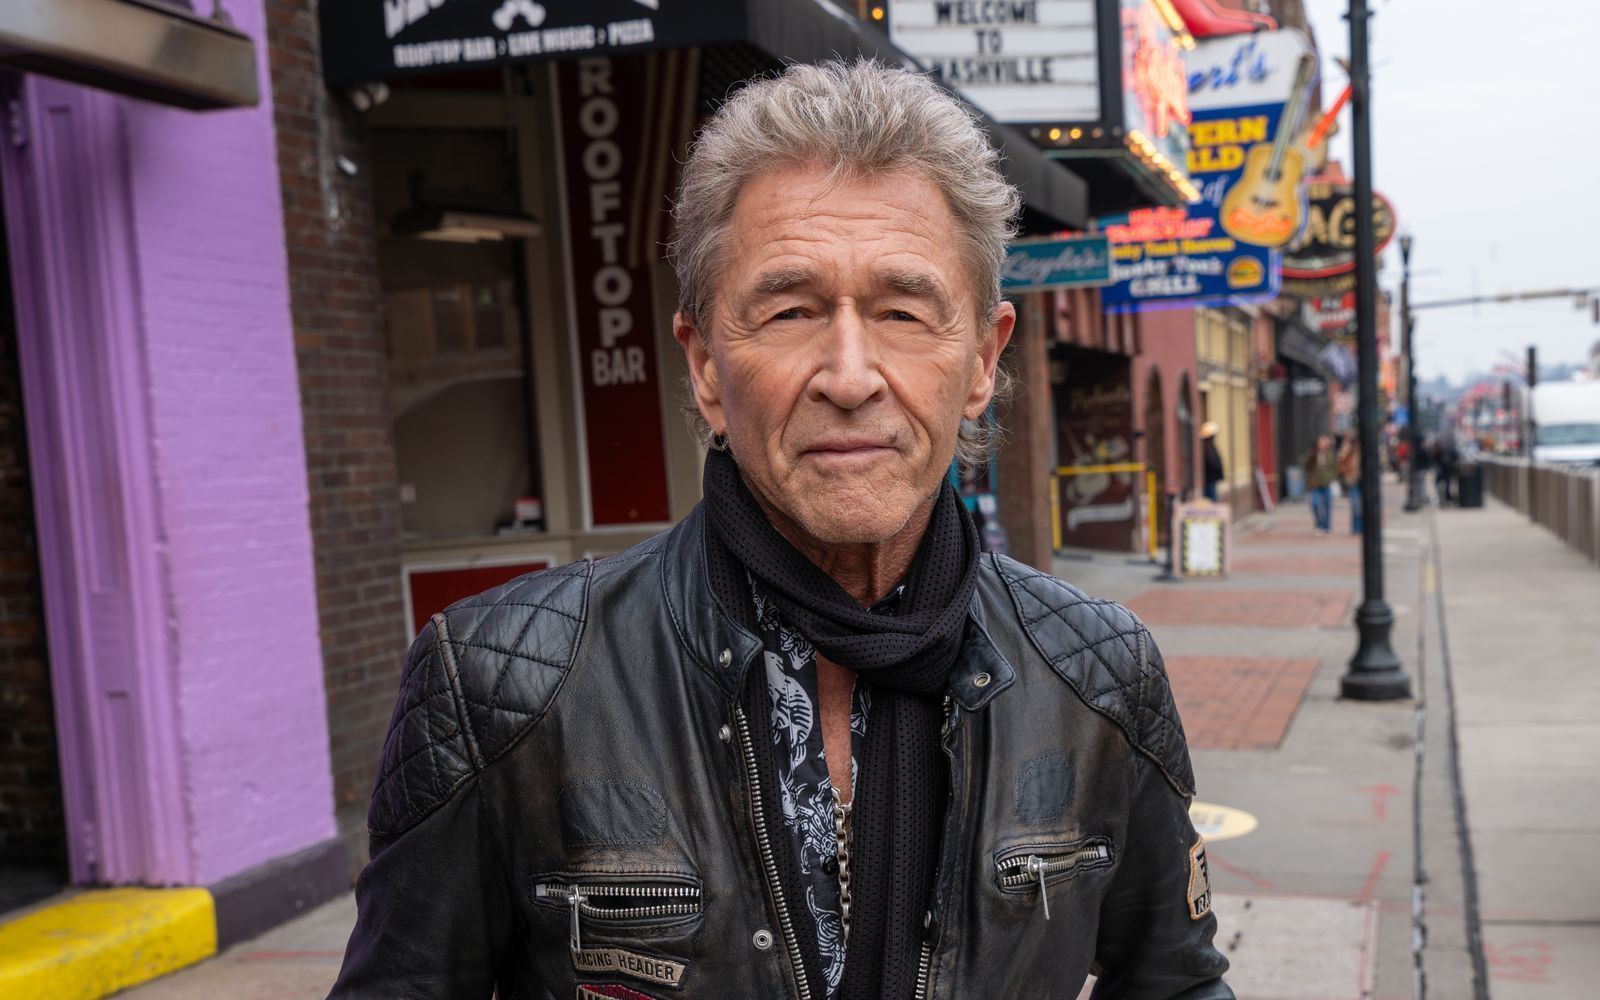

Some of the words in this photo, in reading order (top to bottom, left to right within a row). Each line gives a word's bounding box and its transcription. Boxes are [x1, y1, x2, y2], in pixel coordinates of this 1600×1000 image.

[934, 0, 1037, 24] WELCOME
[393, 39, 460, 67] ROOFTOP
[462, 36, 497, 61] BAR
[507, 31, 541, 57] LIVE
[541, 24, 596, 52] MUSIC
[607, 18, 655, 46] PIZZA
[975, 29, 1003, 55] TO
[578, 57, 633, 348] ROOFTOP
[592, 346, 647, 387] BAR
[575, 951, 613, 968] RACING
[617, 953, 675, 981] HEADER
